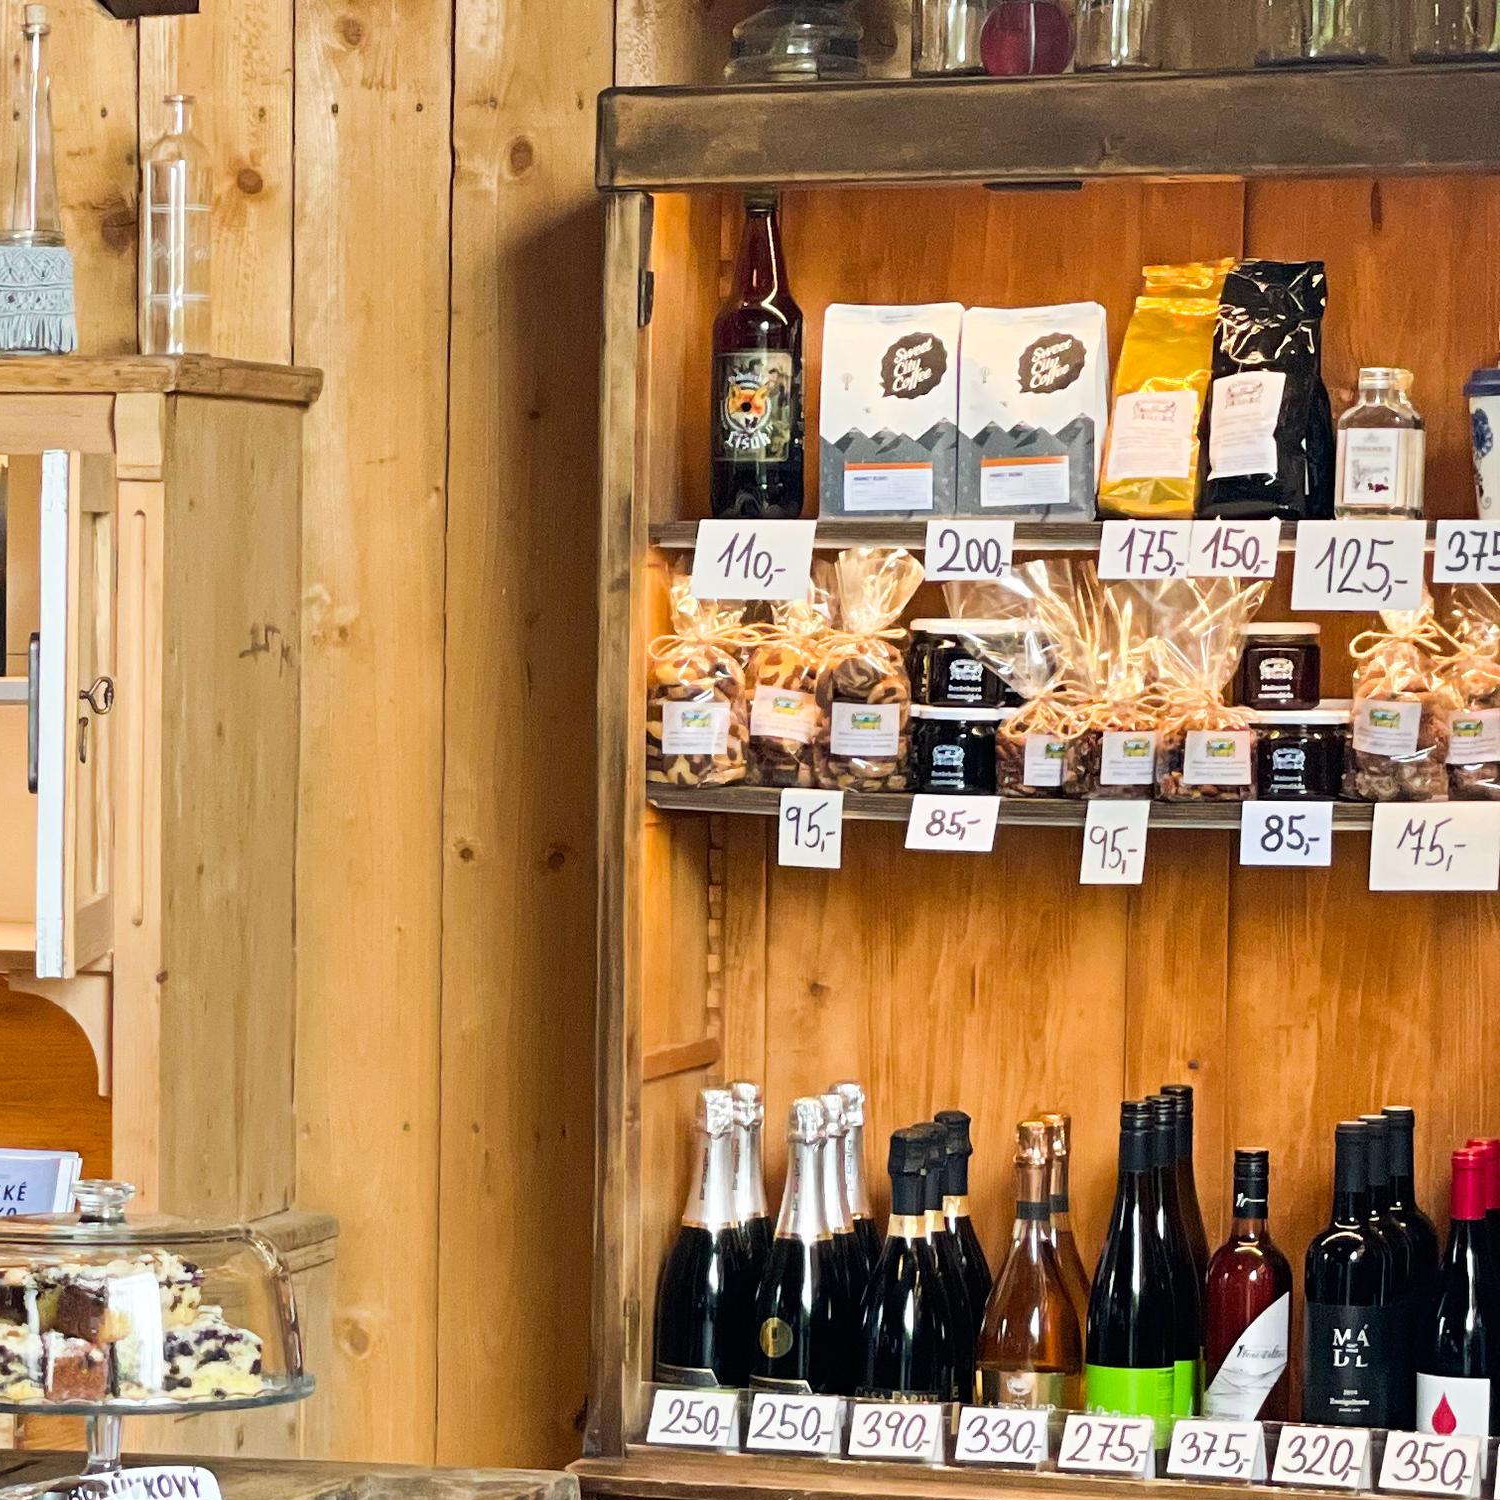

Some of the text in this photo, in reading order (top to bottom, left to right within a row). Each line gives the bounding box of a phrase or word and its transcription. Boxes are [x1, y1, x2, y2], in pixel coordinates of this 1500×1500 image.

[892, 368, 932, 391] Coffee
[1029, 364, 1070, 389] Coffee
[936, 528, 1010, 577] 200,-
[1117, 527, 1185, 576] 175,-
[1201, 526, 1270, 574] 150,-
[1315, 536, 1408, 601] 125,-
[785, 801, 836, 852] 95,-
[925, 809, 981, 840] 85,-
[1260, 814, 1320, 856] 85,-
[1089, 825, 1138, 875] 95,-
[660, 1398, 730, 1442] 250,-
[752, 1402, 833, 1446] 250,-
[857, 1410, 931, 1452] 390,-
[964, 1415, 1042, 1460] 330,-
[1066, 1422, 1148, 1467] 275,-
[1180, 1431, 1251, 1475] 375,-
[1281, 1434, 1361, 1482] 320,-
[1392, 1439, 1472, 1491] 350,-
